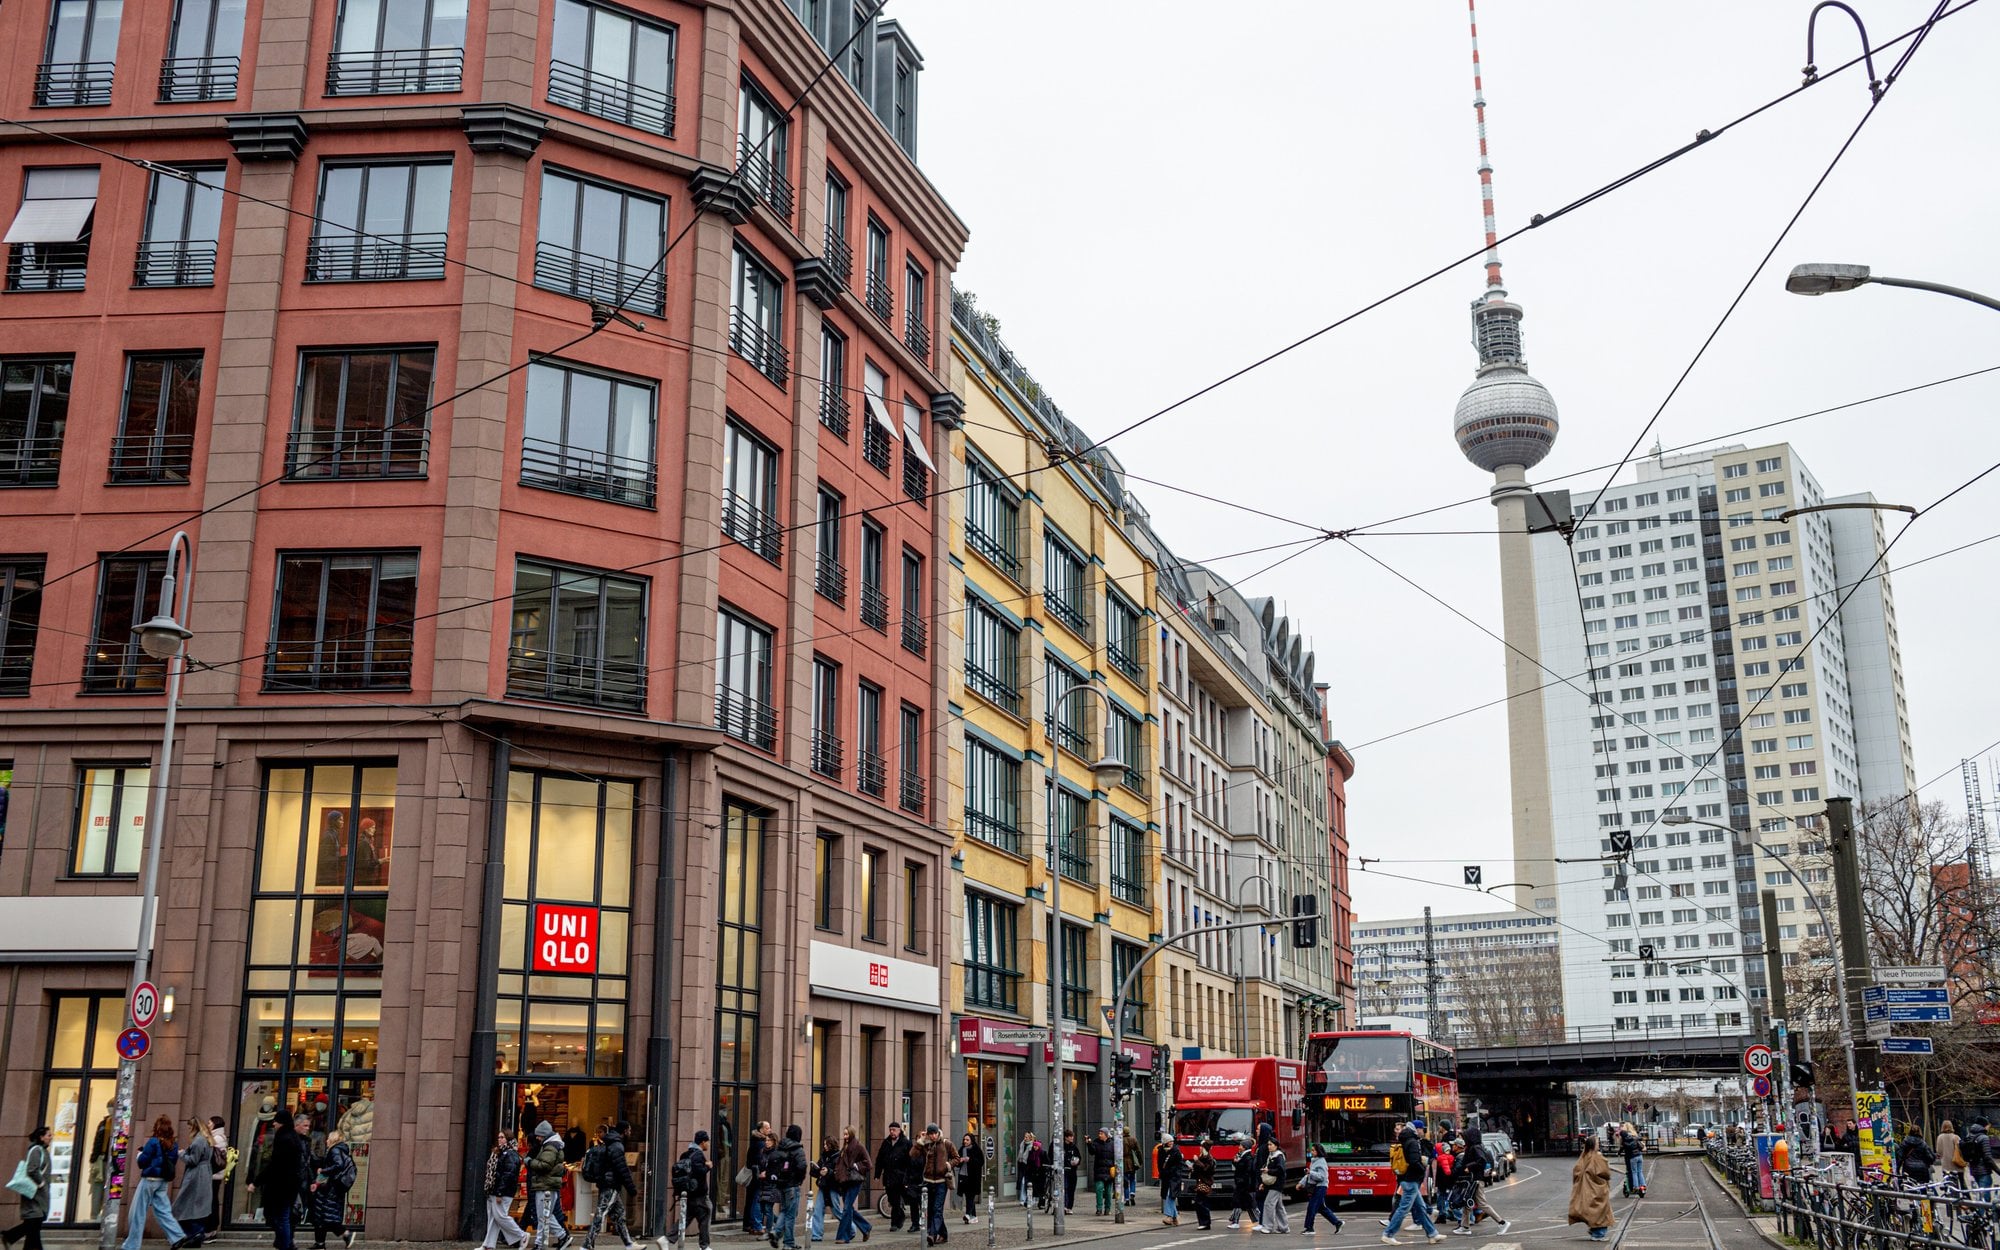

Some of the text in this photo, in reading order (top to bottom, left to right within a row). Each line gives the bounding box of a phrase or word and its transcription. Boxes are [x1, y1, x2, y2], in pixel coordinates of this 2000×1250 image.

[544, 913, 587, 937] UNI
[542, 940, 589, 966] QLO
[1881, 969, 1941, 978] Neue Promenade
[136, 994, 153, 1016] 30
[962, 1030, 977, 1038] MUJI
[1751, 1053, 1769, 1067] 30
[1186, 1076, 1247, 1087] Höffner
[1344, 1098, 1367, 1110] KIEZ
